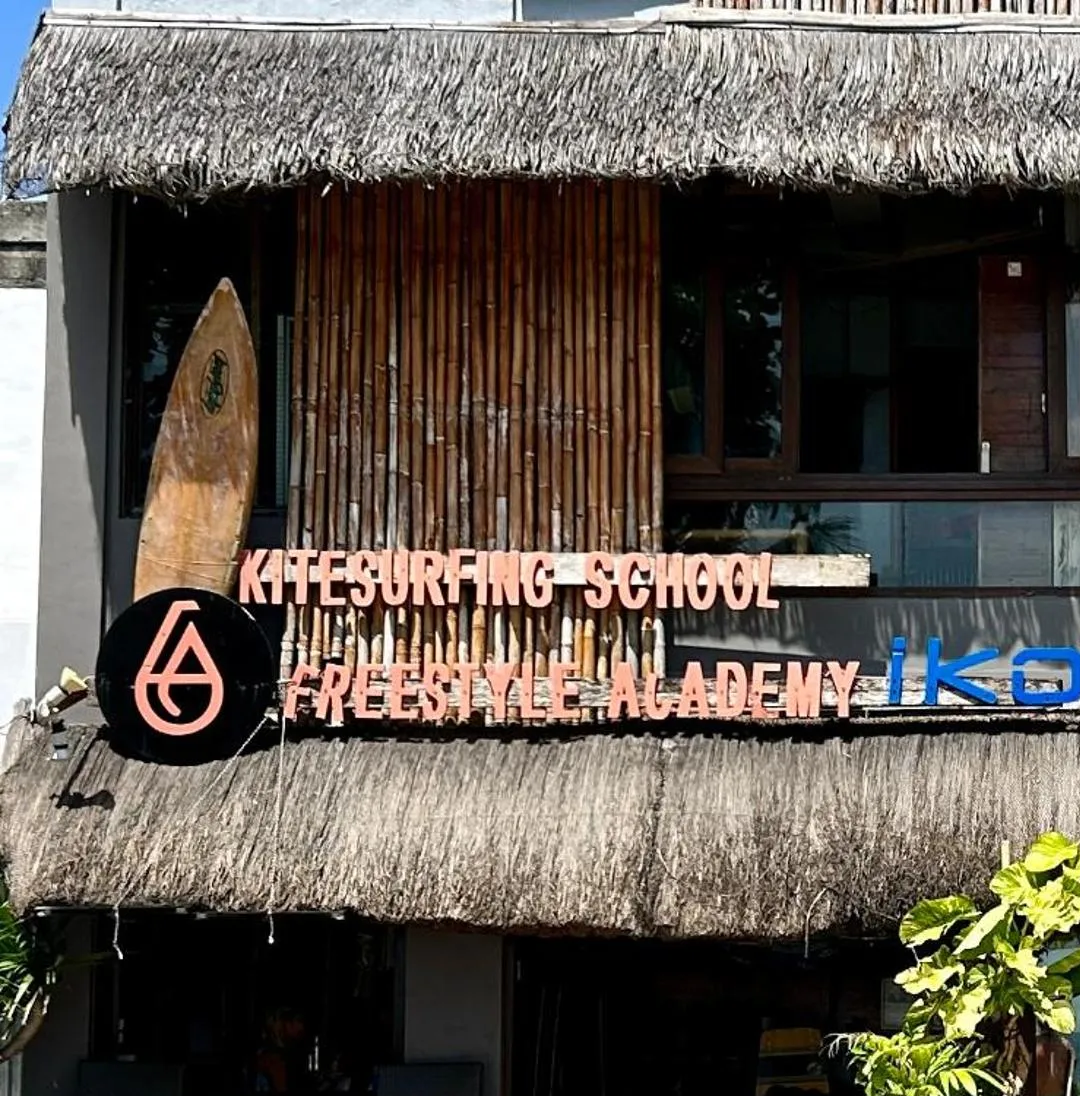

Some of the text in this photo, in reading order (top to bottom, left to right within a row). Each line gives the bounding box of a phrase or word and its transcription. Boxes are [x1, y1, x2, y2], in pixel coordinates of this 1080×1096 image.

[238, 549, 780, 611] KITESURFING SCHOOL
[282, 661, 860, 721] FREESTYLE ACADEMY
